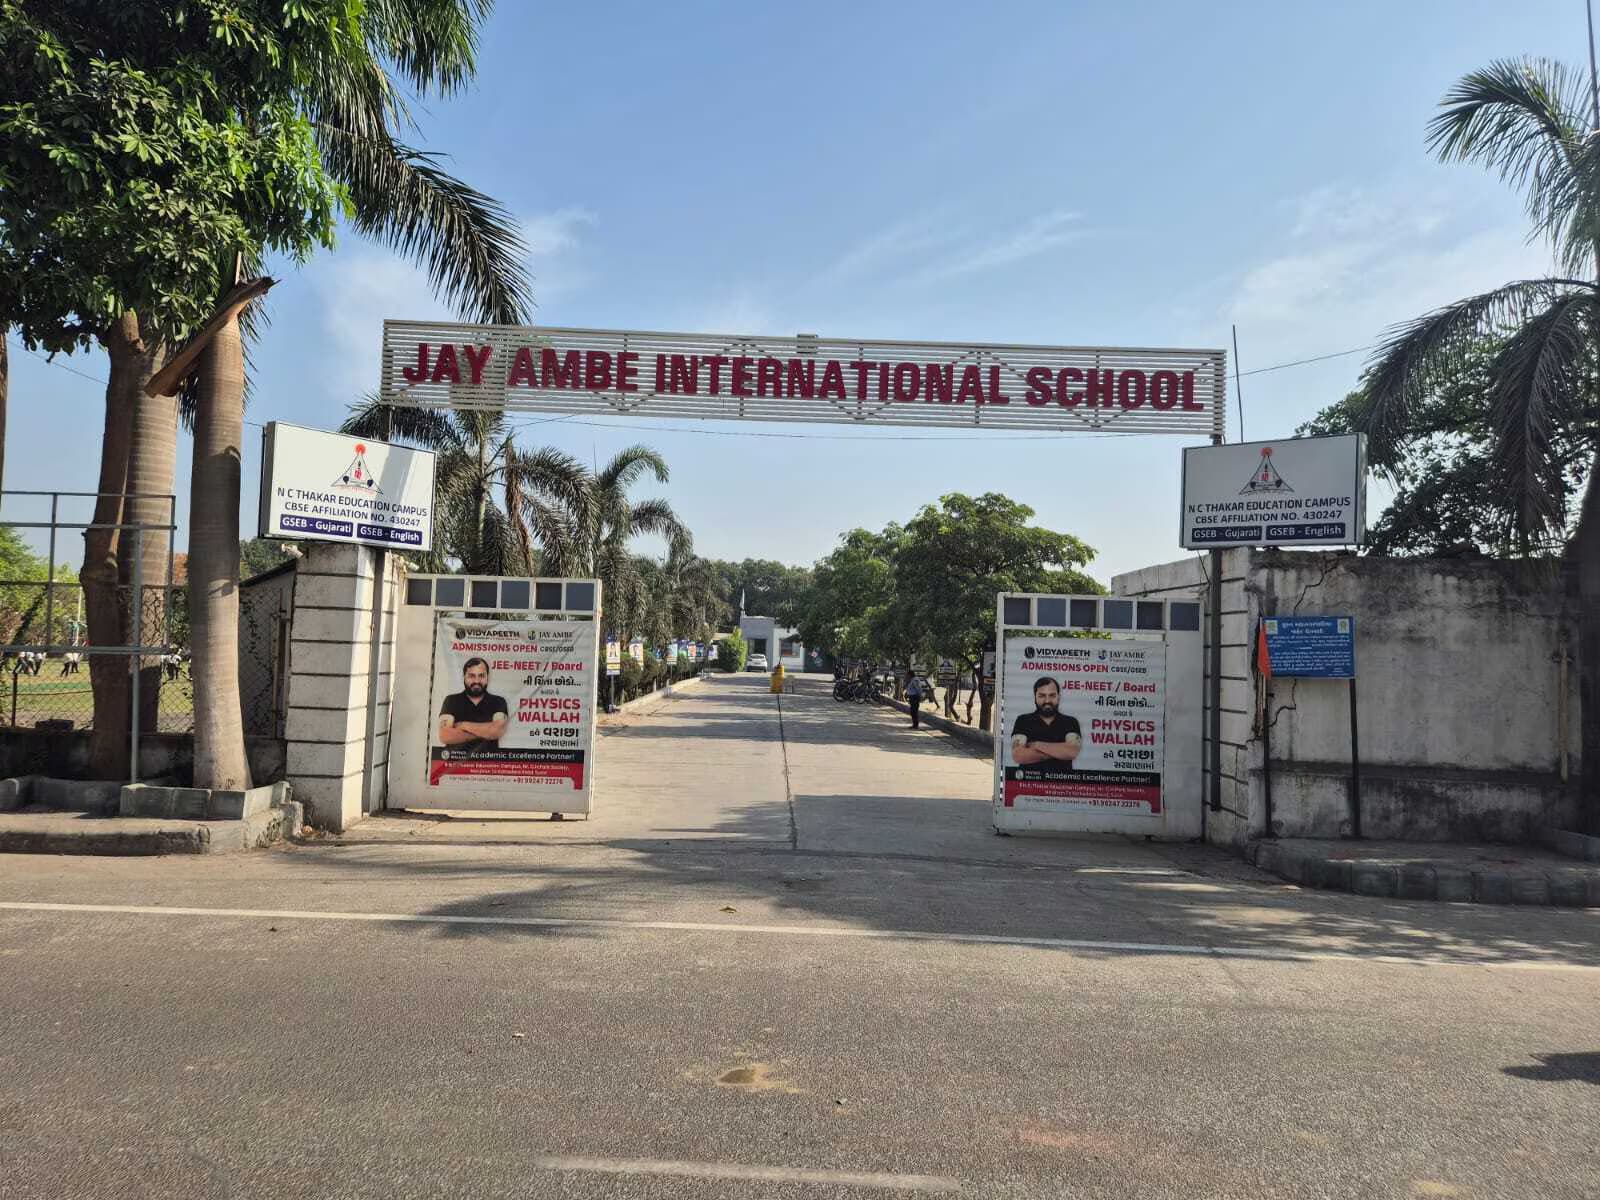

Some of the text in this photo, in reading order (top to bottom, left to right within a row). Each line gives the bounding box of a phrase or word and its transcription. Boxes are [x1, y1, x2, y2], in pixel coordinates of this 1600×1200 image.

[403, 343, 1204, 411] JAY AMBE INTERNATIONAL SCHOOL
[277, 487, 427, 517] N C THAKAR EDUCATION CAMPUS
[1188, 496, 1351, 513] N C THAKAR EDUCATION CAMPUS
[284, 501, 421, 527] CBSE AFFILIATION NO. 430247
[1195, 510, 1342, 524] CBSE AFFILIATION NO. 430247
[282, 516, 307, 529] GSEB
[315, 521, 351, 534] Gujarati
[1269, 526, 1296, 536] GSEB
[1305, 525, 1342, 537] English
[360, 526, 383, 537] GSEB
[390, 529, 420, 542] English
[1193, 529, 1217, 538] GSEB
[1225, 527, 1260, 539] Gujarati
[466, 629, 520, 638] VIDYAPEETH
[452, 642, 538, 653] ADMISSIONS OPEN
[1036, 648, 1090, 657] VIDYAPEETH
[1110, 650, 1145, 659] JAY AMBE
[491, 660, 542, 671] JEE-NEET
[551, 661, 583, 671] Board
[1021, 661, 1109, 673] ADMISSIONS OPEN
[1062, 680, 1113, 691] JEE-NEET
[1123, 682, 1156, 693] Board
[519, 698, 581, 710] PHYSICS
[517, 711, 580, 723] WALLAH
[1091, 718, 1155, 732] PHYSICS
[1090, 732, 1154, 745] WALLAH
[1045, 772, 1081, 780] Academic
[1082, 774, 1120, 782] Excellence
